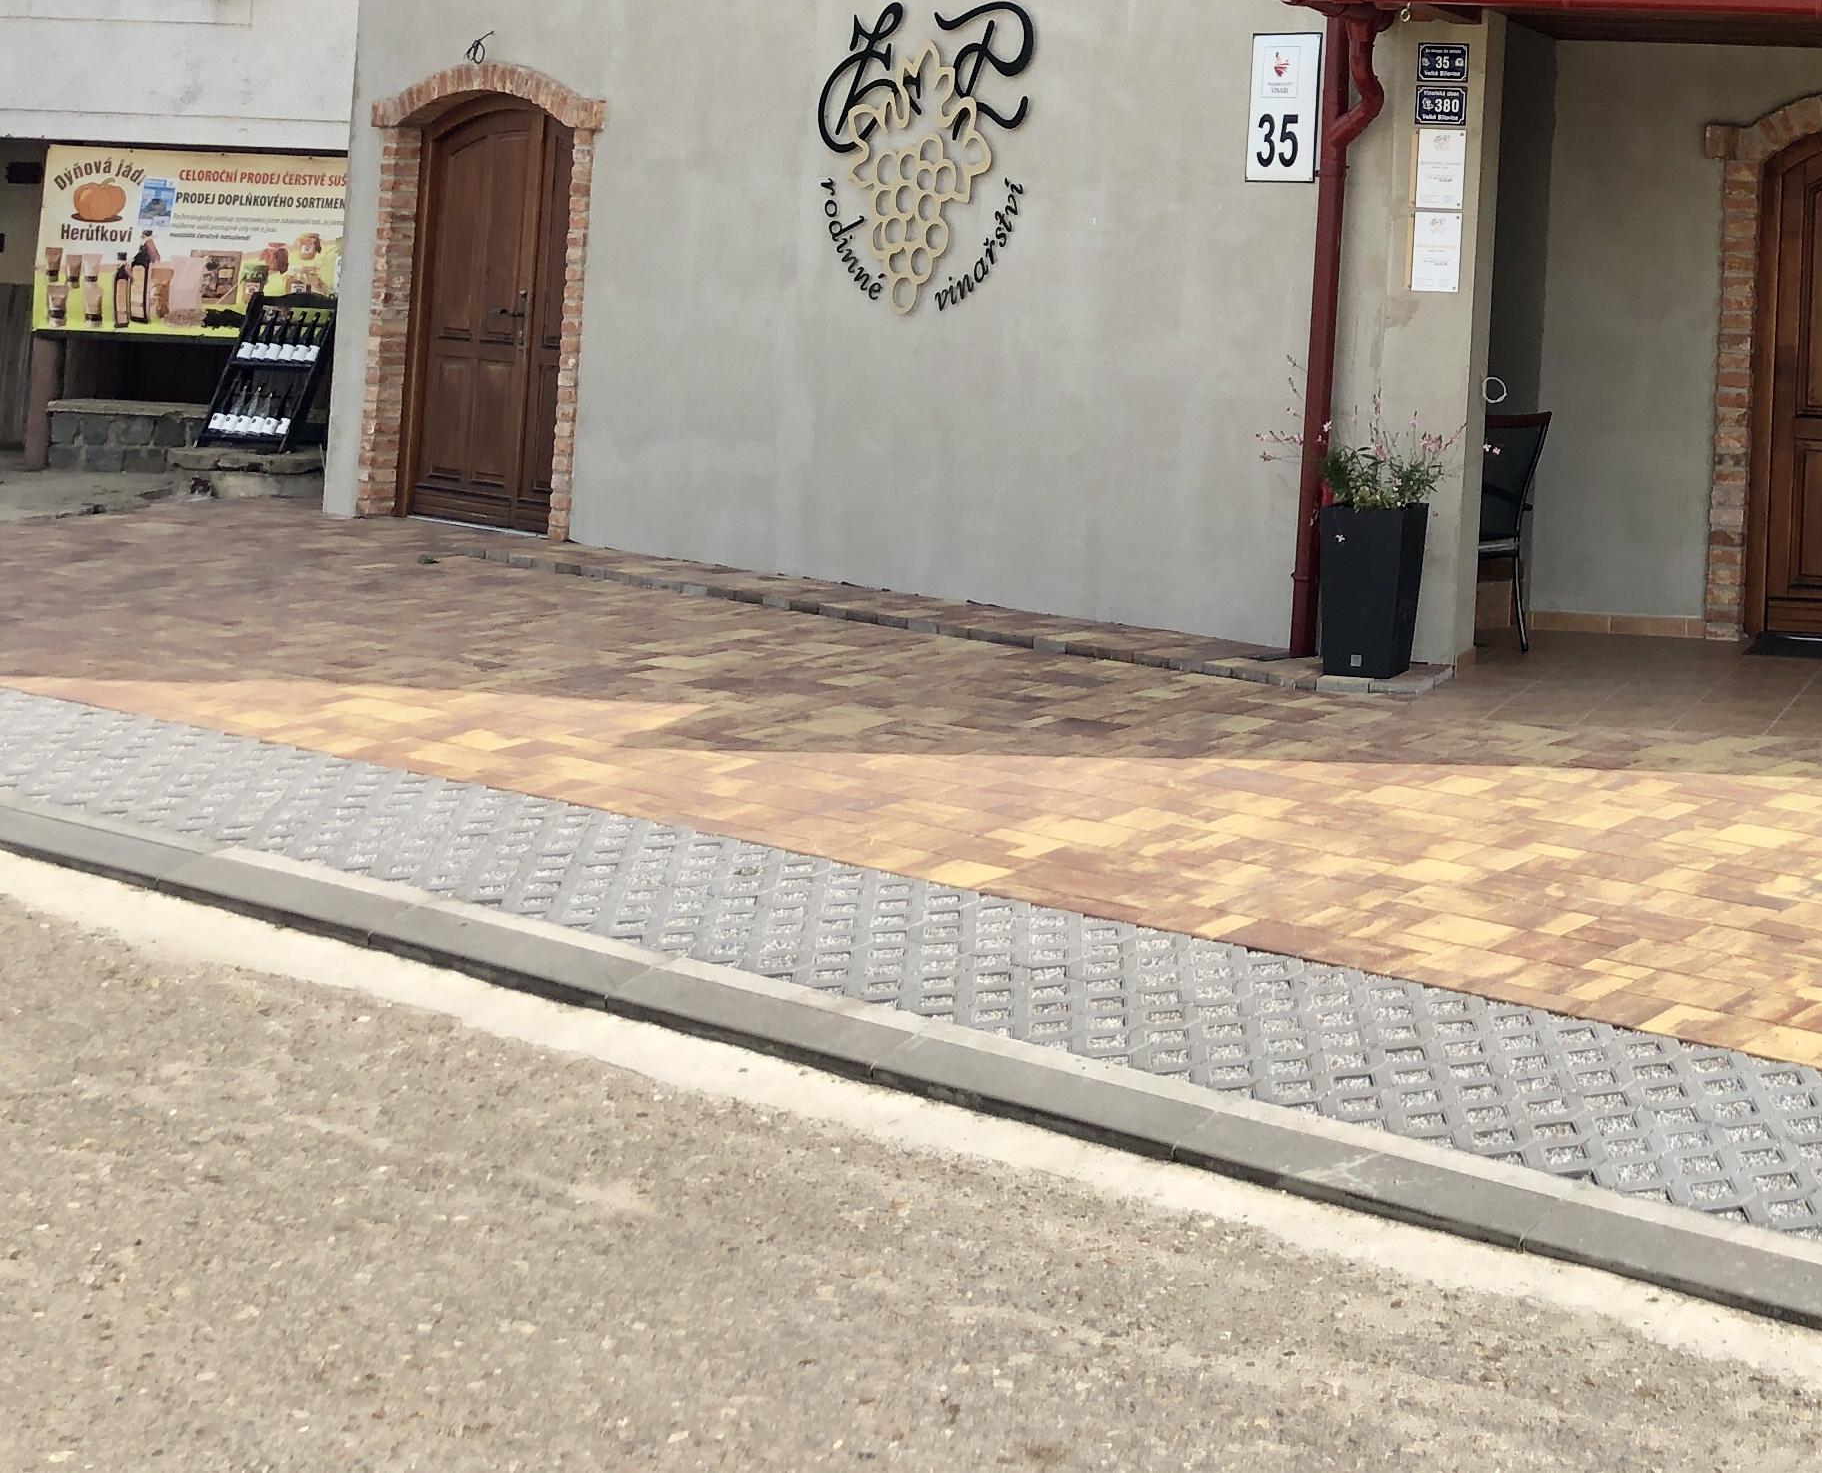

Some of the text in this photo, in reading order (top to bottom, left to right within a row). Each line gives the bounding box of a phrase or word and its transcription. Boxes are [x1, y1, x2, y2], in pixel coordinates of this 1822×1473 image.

[1435, 55, 1450, 69] 35
[1434, 98, 1460, 113] 380
[1256, 113, 1299, 168] 35
[54, 157, 113, 190] Dýňová
[179, 169, 238, 183] CELOROČNÍ
[239, 171, 281, 185] PRODEJ
[175, 191, 215, 205] PRODEJ
[217, 192, 294, 208] DOPLŇKOVÉHO
[60, 223, 133, 242] Herůfkovi
[820, 177, 886, 301] rodinné
[935, 177, 1024, 312] vinařství
